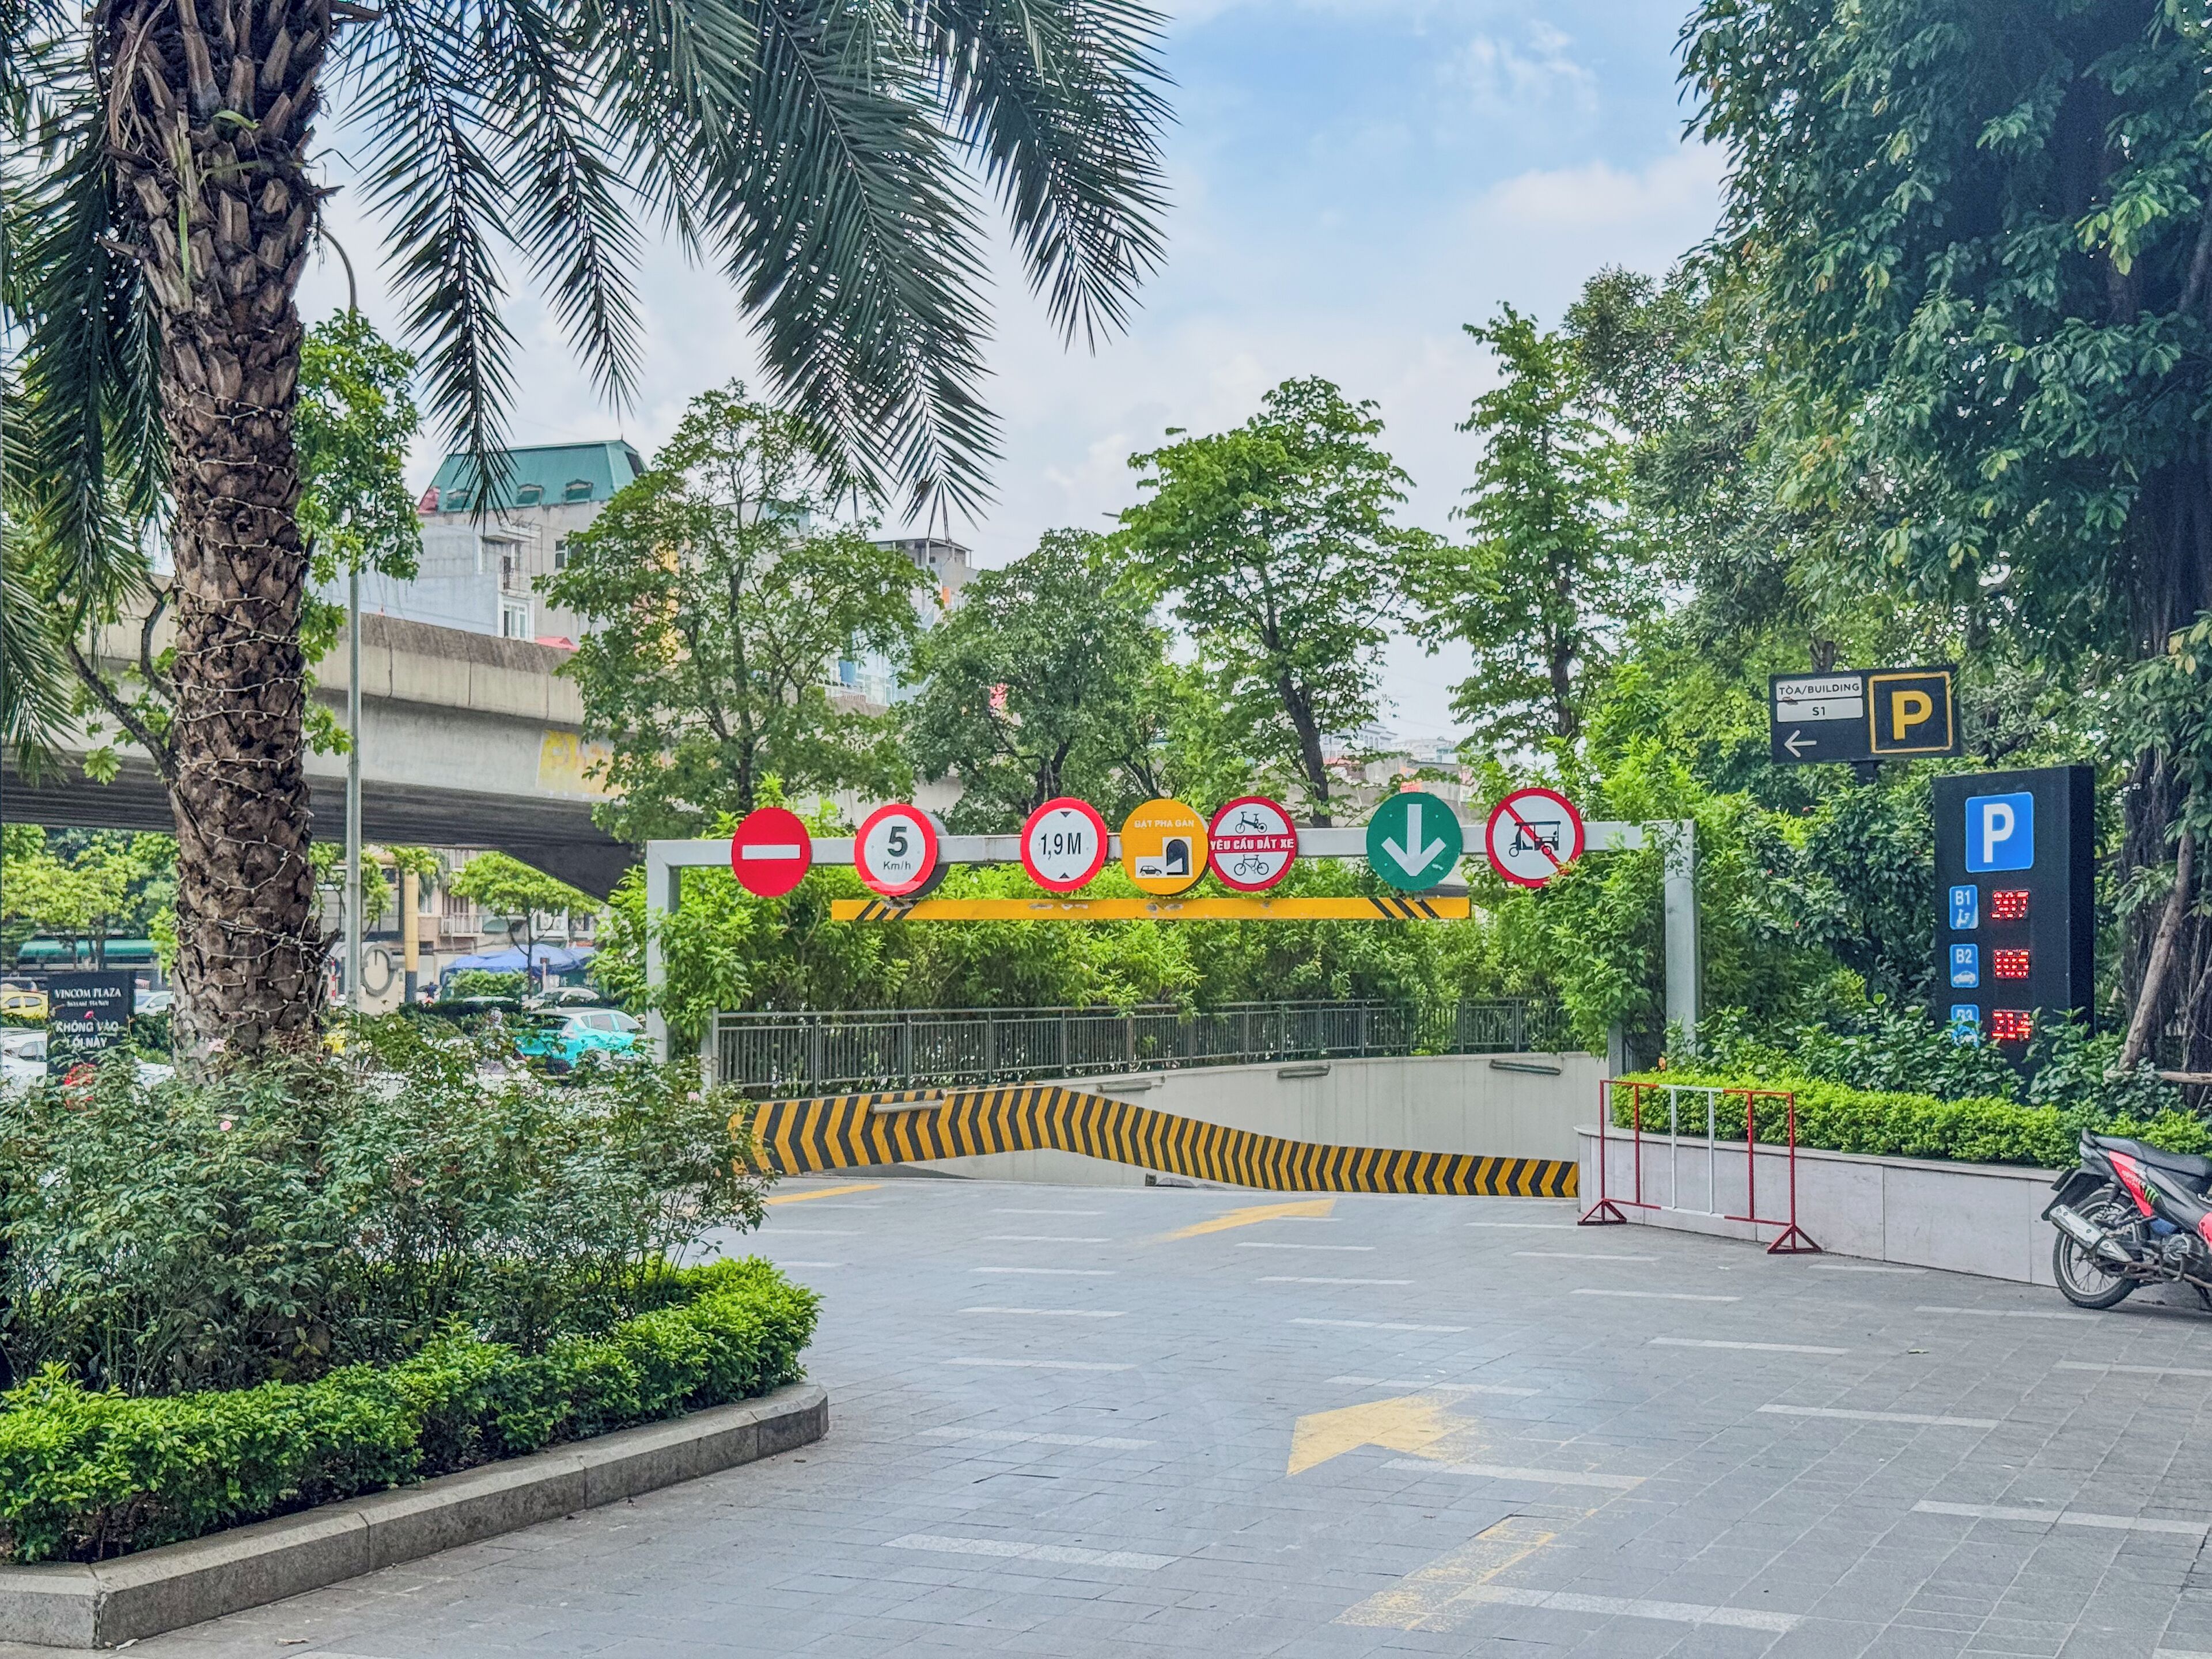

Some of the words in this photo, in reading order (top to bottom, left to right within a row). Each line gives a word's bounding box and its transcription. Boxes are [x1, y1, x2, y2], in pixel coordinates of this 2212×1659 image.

[1779, 683, 1859, 695] TÒA/BUILDING
[1812, 706, 1825, 716] S1
[1892, 690, 1933, 740] P
[1983, 803, 2014, 863] P
[888, 826, 908, 857] 5
[1210, 839, 1230, 850] YÊU
[1281, 839, 1294, 849] XE
[884, 861, 911, 870] Km/h
[1955, 890, 1971, 906] B1
[1956, 949, 1972, 964] B2
[55, 988, 91, 998] VINCOM
[56, 1020, 94, 1033] KHÔNG
